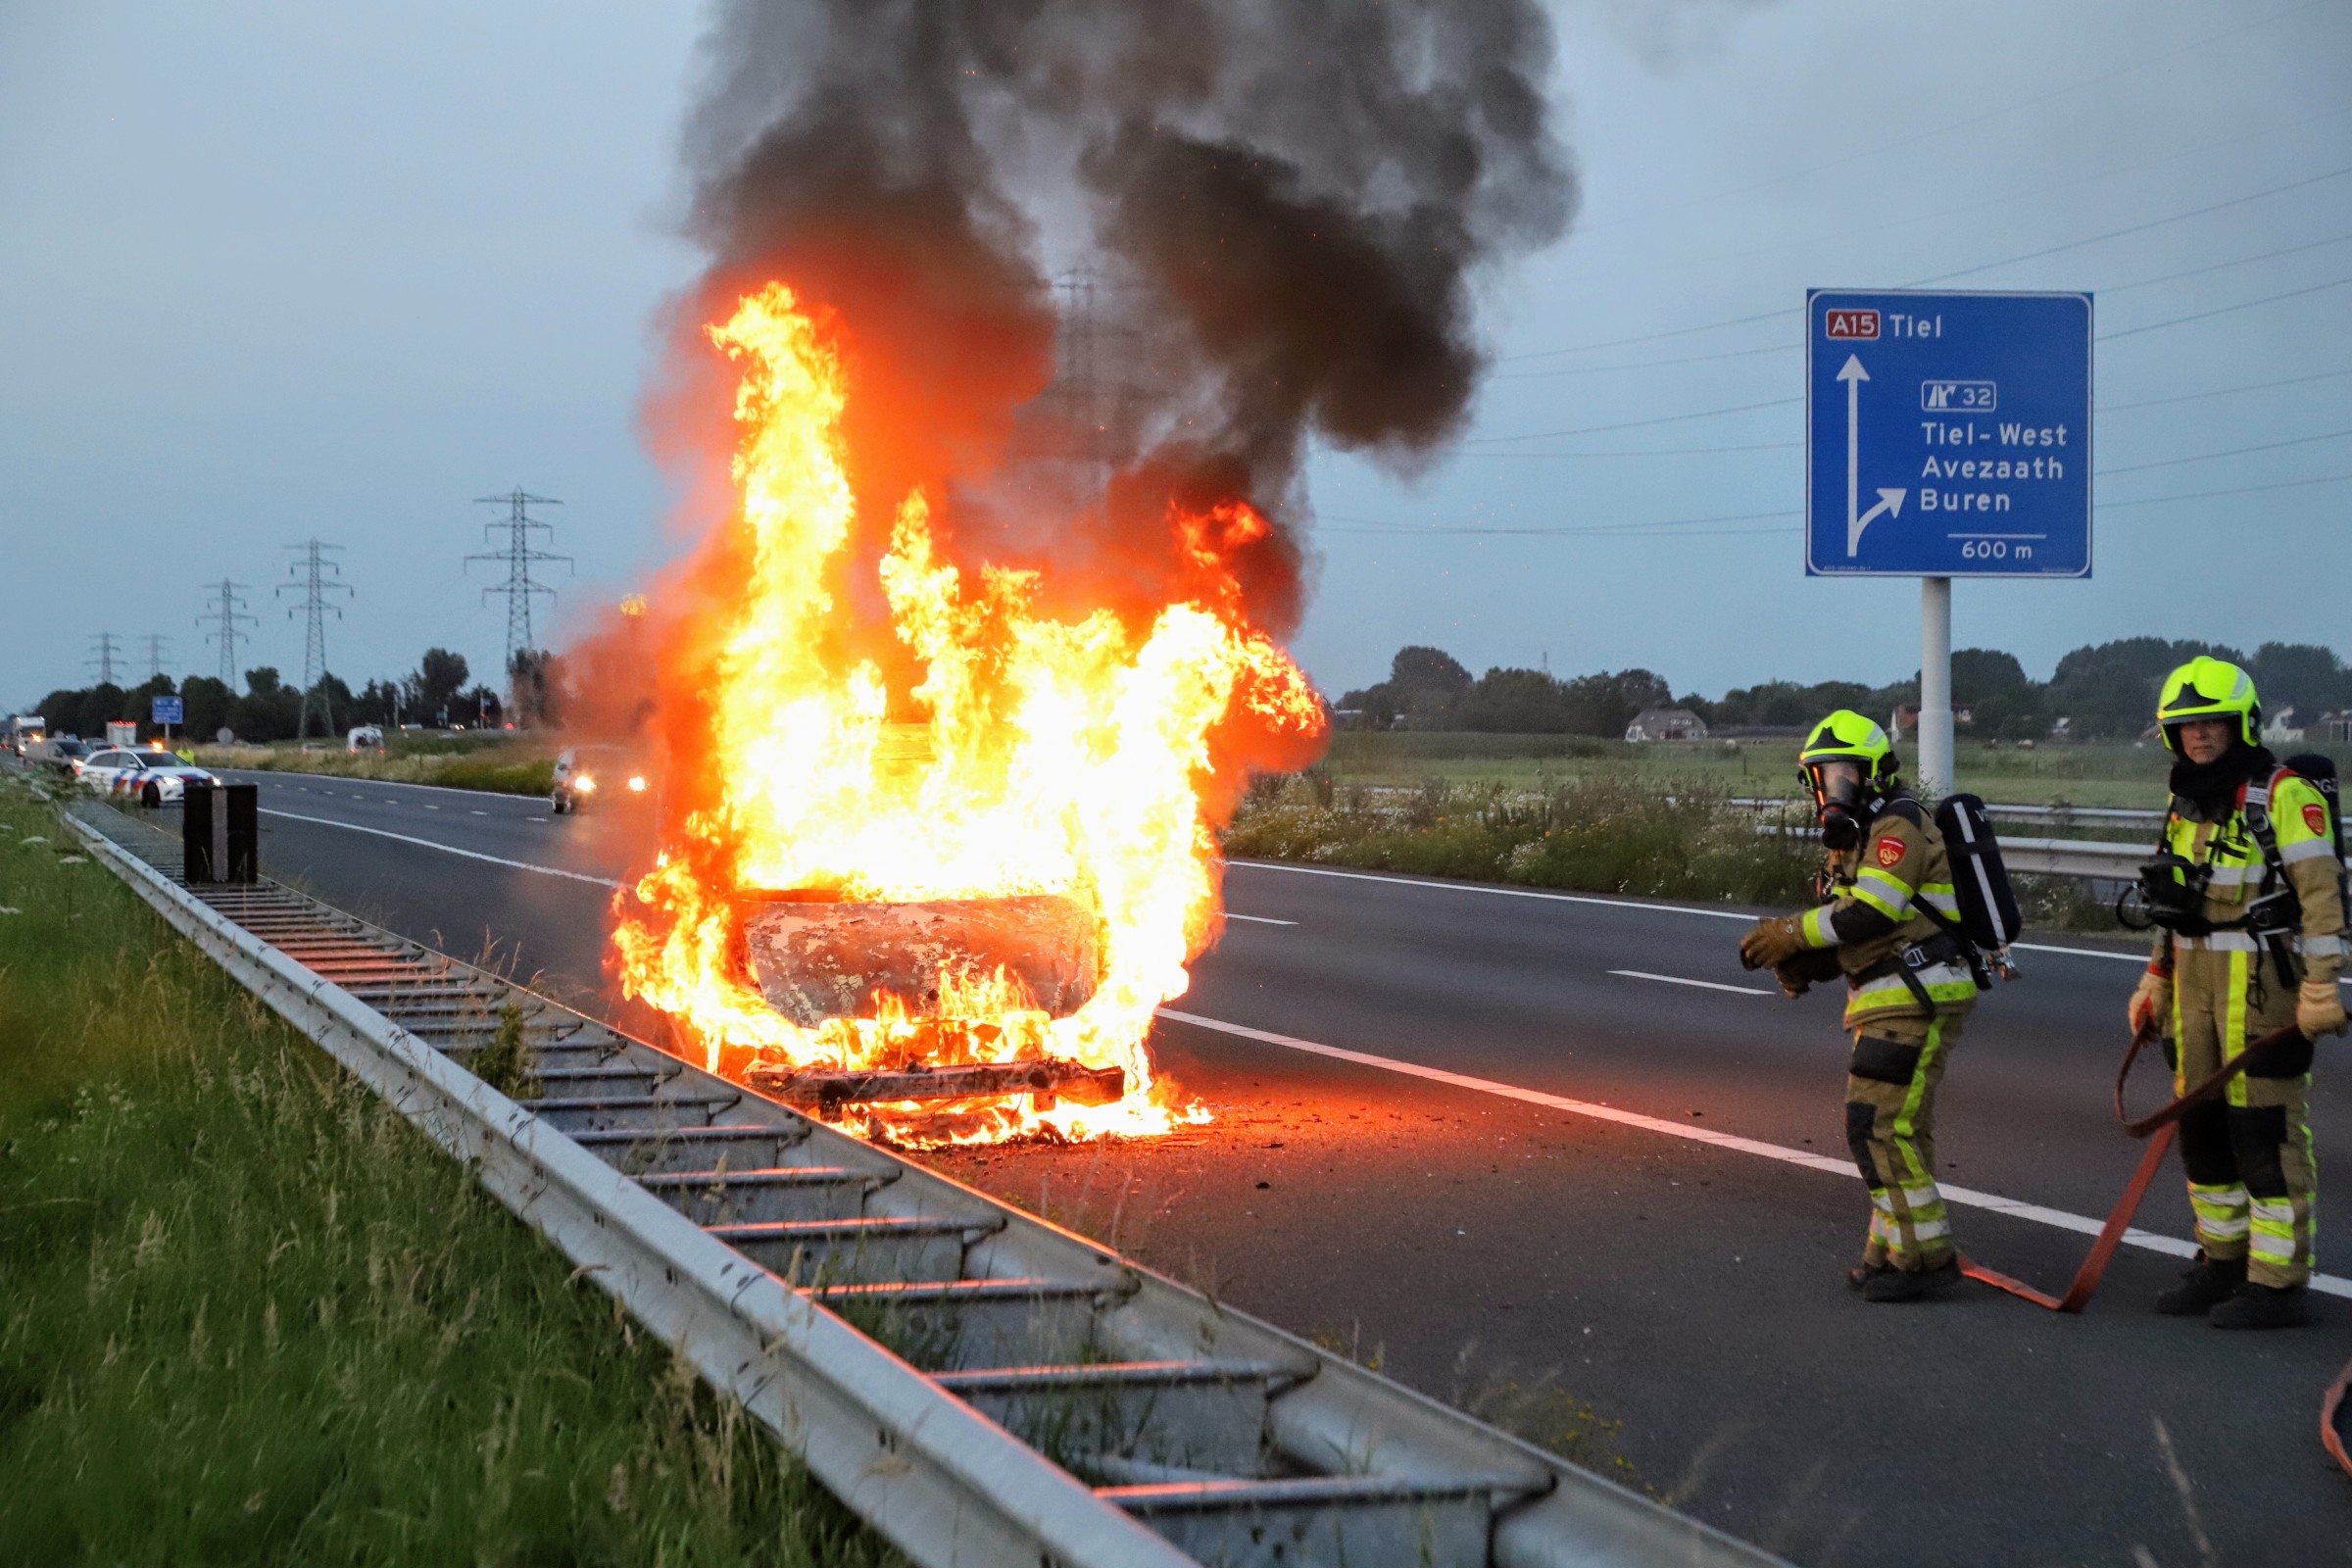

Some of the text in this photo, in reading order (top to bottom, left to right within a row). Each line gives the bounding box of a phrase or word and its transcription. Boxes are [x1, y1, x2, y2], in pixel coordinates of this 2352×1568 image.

[1832, 315, 1941, 337] A15 Tiel
[1963, 388, 1991, 406] 32
[1921, 422, 2067, 446] Tiel-West
[1922, 456, 2064, 478] Avezaath
[1921, 488, 2010, 512] Buren
[1962, 541, 2032, 559] 600 m
